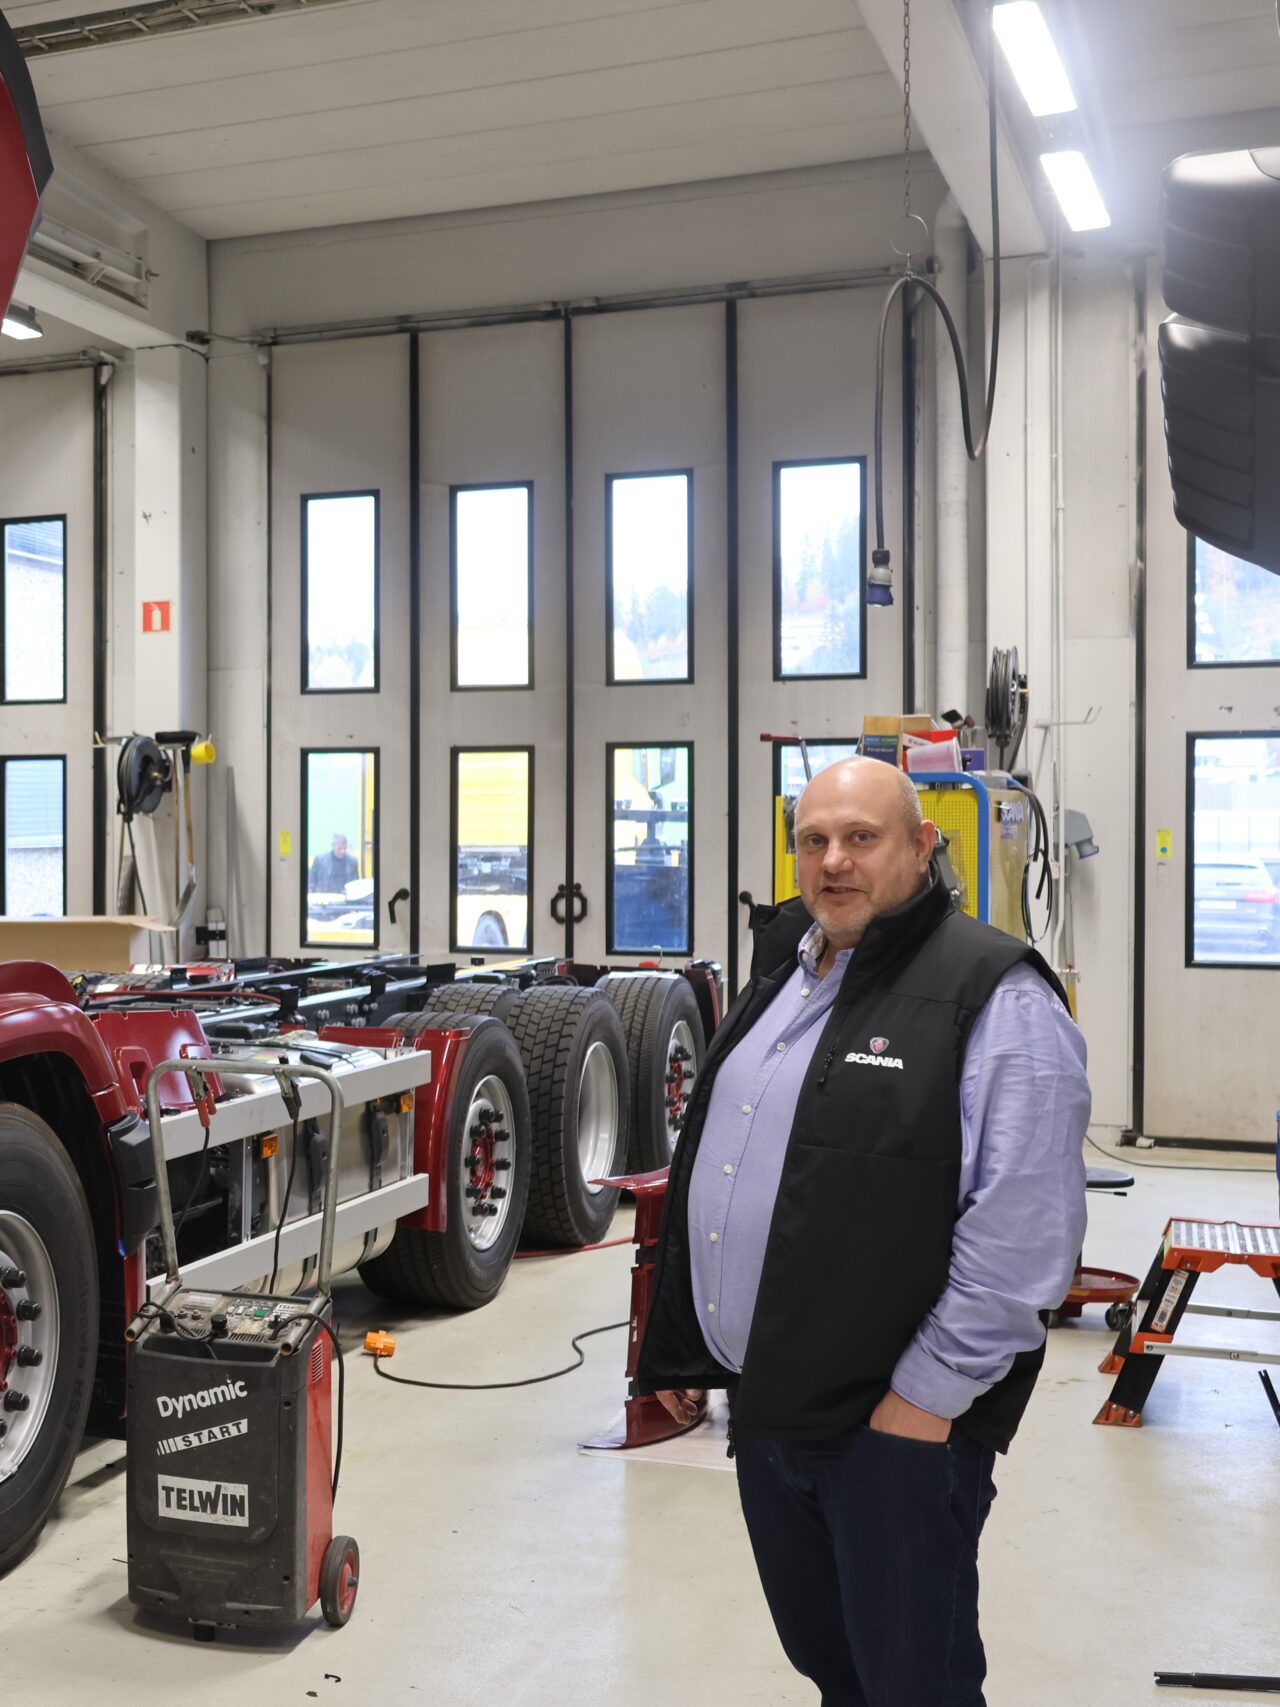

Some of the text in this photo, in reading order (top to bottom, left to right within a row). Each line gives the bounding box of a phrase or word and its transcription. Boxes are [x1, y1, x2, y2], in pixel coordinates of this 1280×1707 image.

[845, 1052, 904, 1069] SCANIA
[156, 1379, 248, 1419] Dynamic
[181, 1421, 243, 1447] START
[161, 1484, 246, 1517] TELWIN
